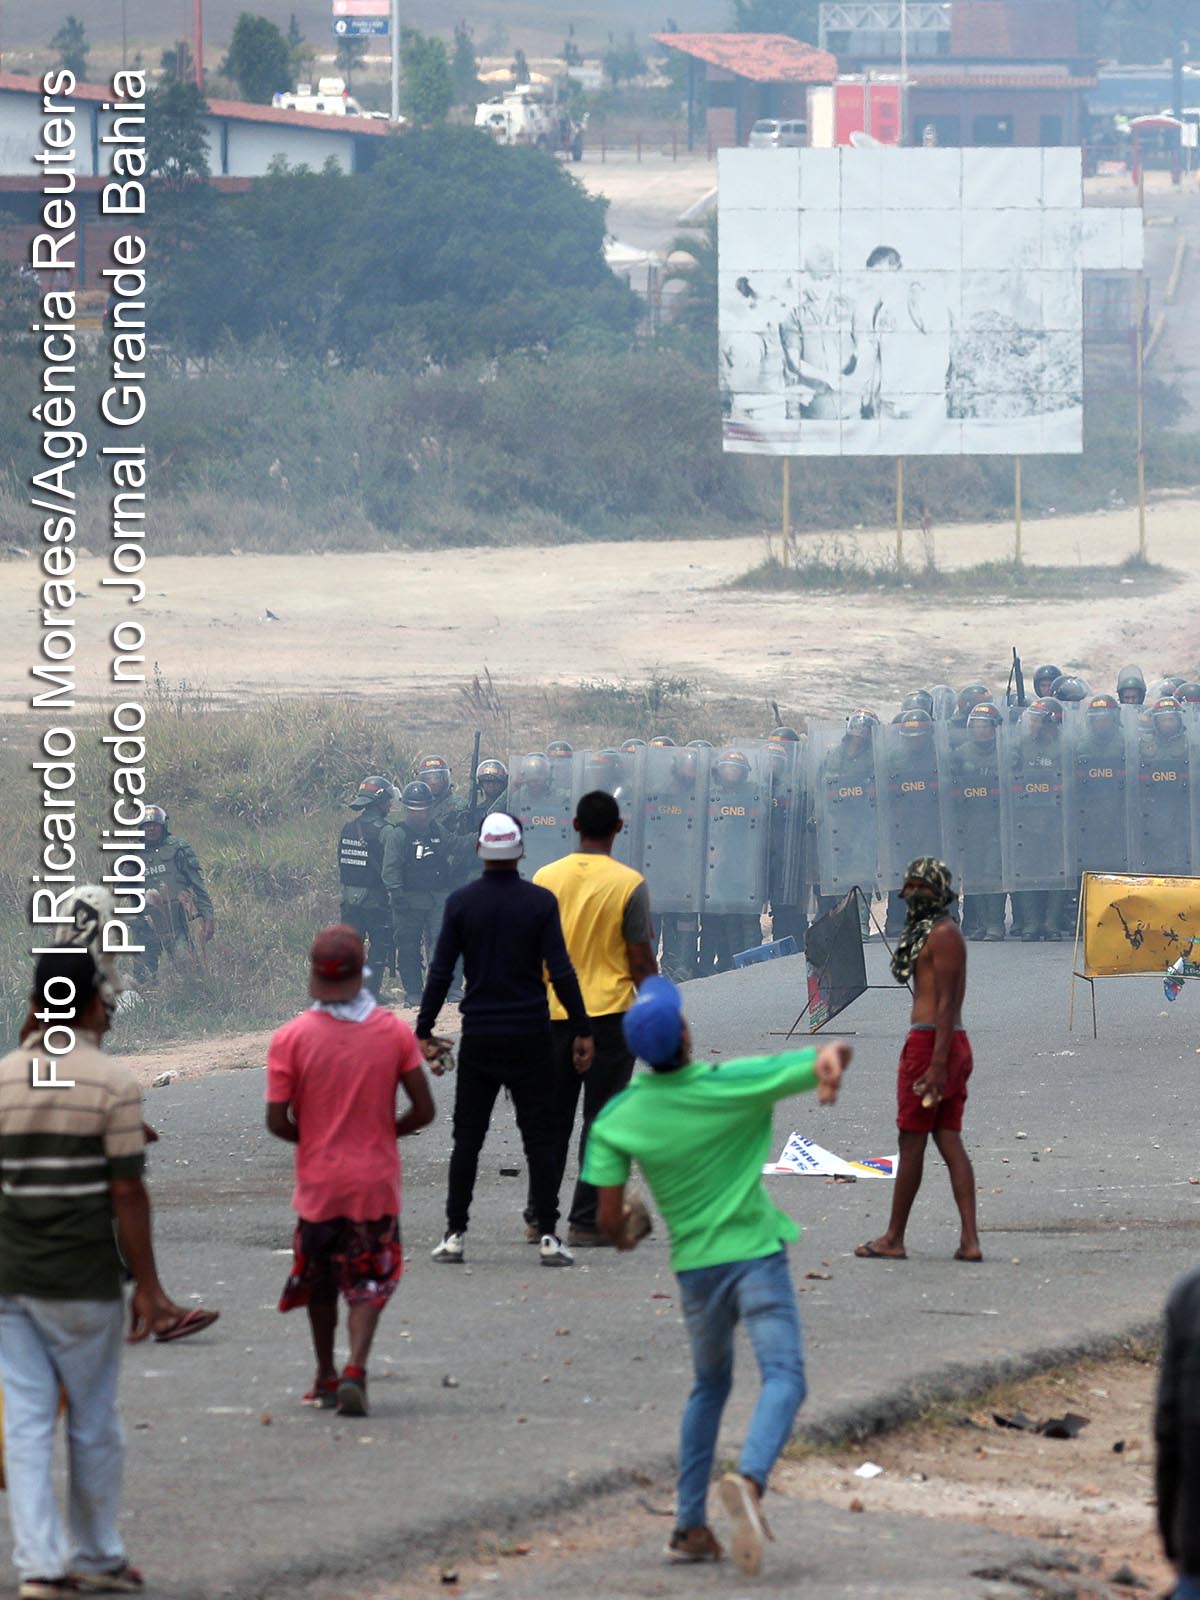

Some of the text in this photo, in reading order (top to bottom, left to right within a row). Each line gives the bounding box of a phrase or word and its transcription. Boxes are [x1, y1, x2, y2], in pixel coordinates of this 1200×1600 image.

[1088, 768, 1113, 778] GNB
[1152, 771, 1176, 781] GNB
[839, 786, 863, 797] GNB
[901, 781, 926, 792] GNB
[1025, 783, 1050, 793] GNB
[964, 787, 987, 797] GNB
[720, 806, 745, 816] GNB
[532, 815, 556, 826] GNB
